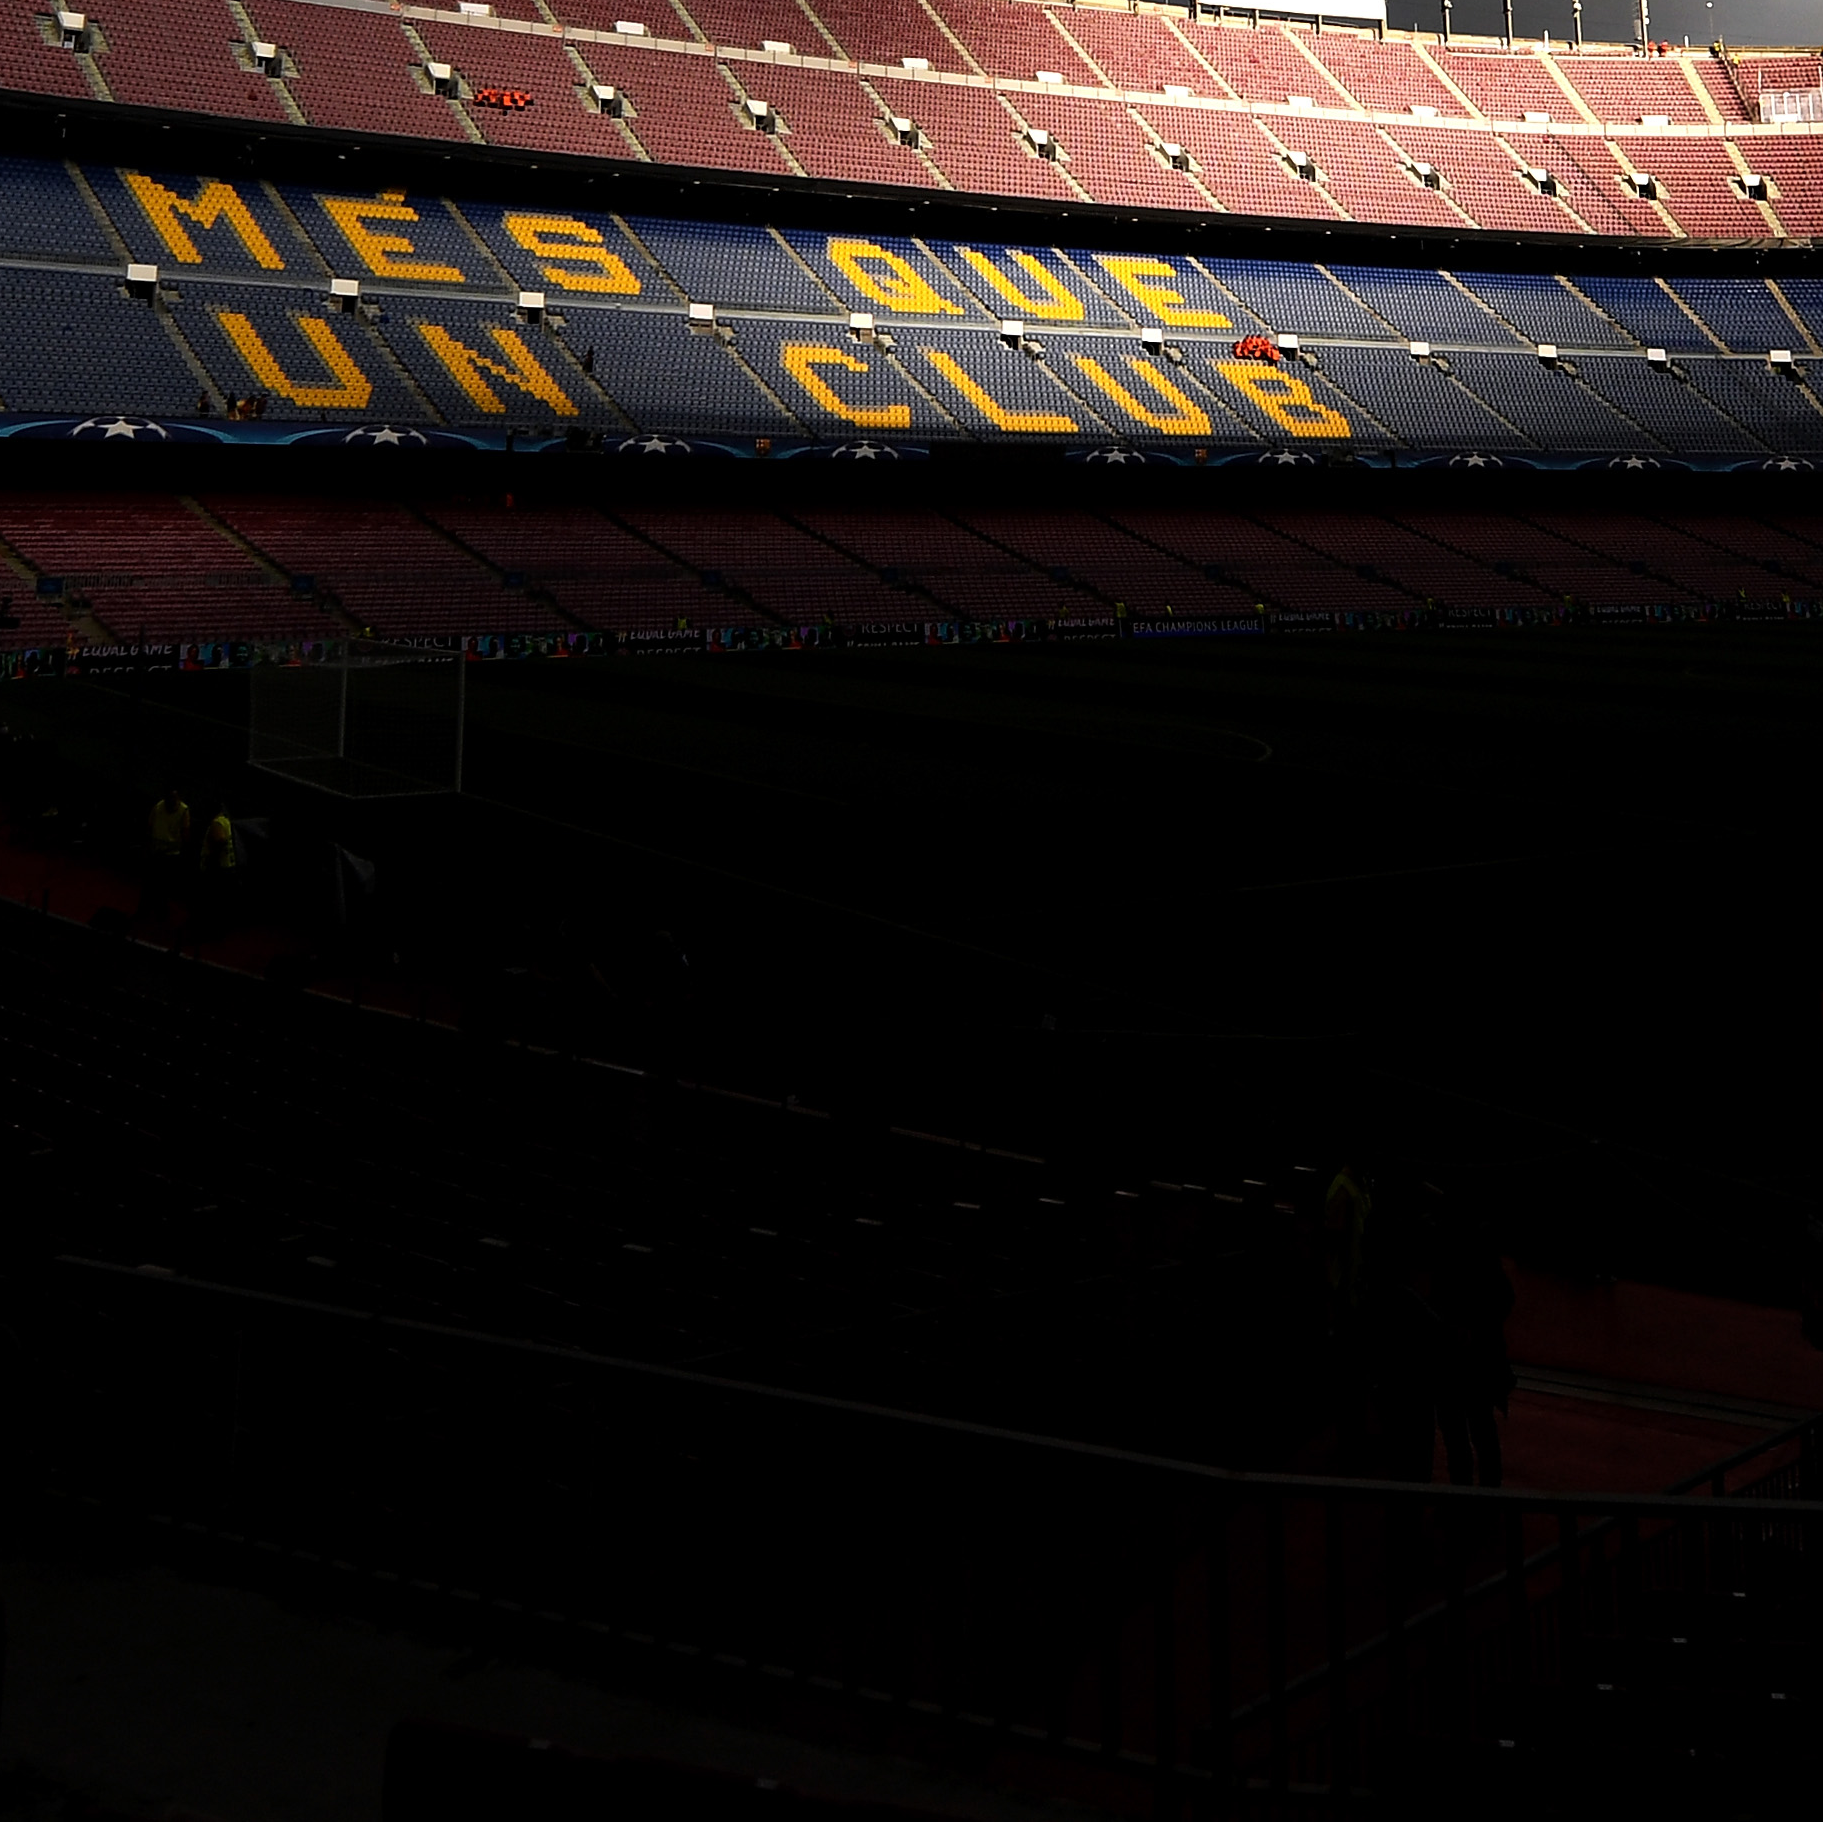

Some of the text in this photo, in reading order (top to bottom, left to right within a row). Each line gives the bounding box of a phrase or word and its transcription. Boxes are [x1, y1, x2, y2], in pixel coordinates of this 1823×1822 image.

[124, 172, 1233, 328] MÉS QUE
[216, 312, 1351, 439] UN CLUB
[1155, 620, 1217, 633] CHAMPIONS
[1221, 619, 1259, 631] LEAGUE
